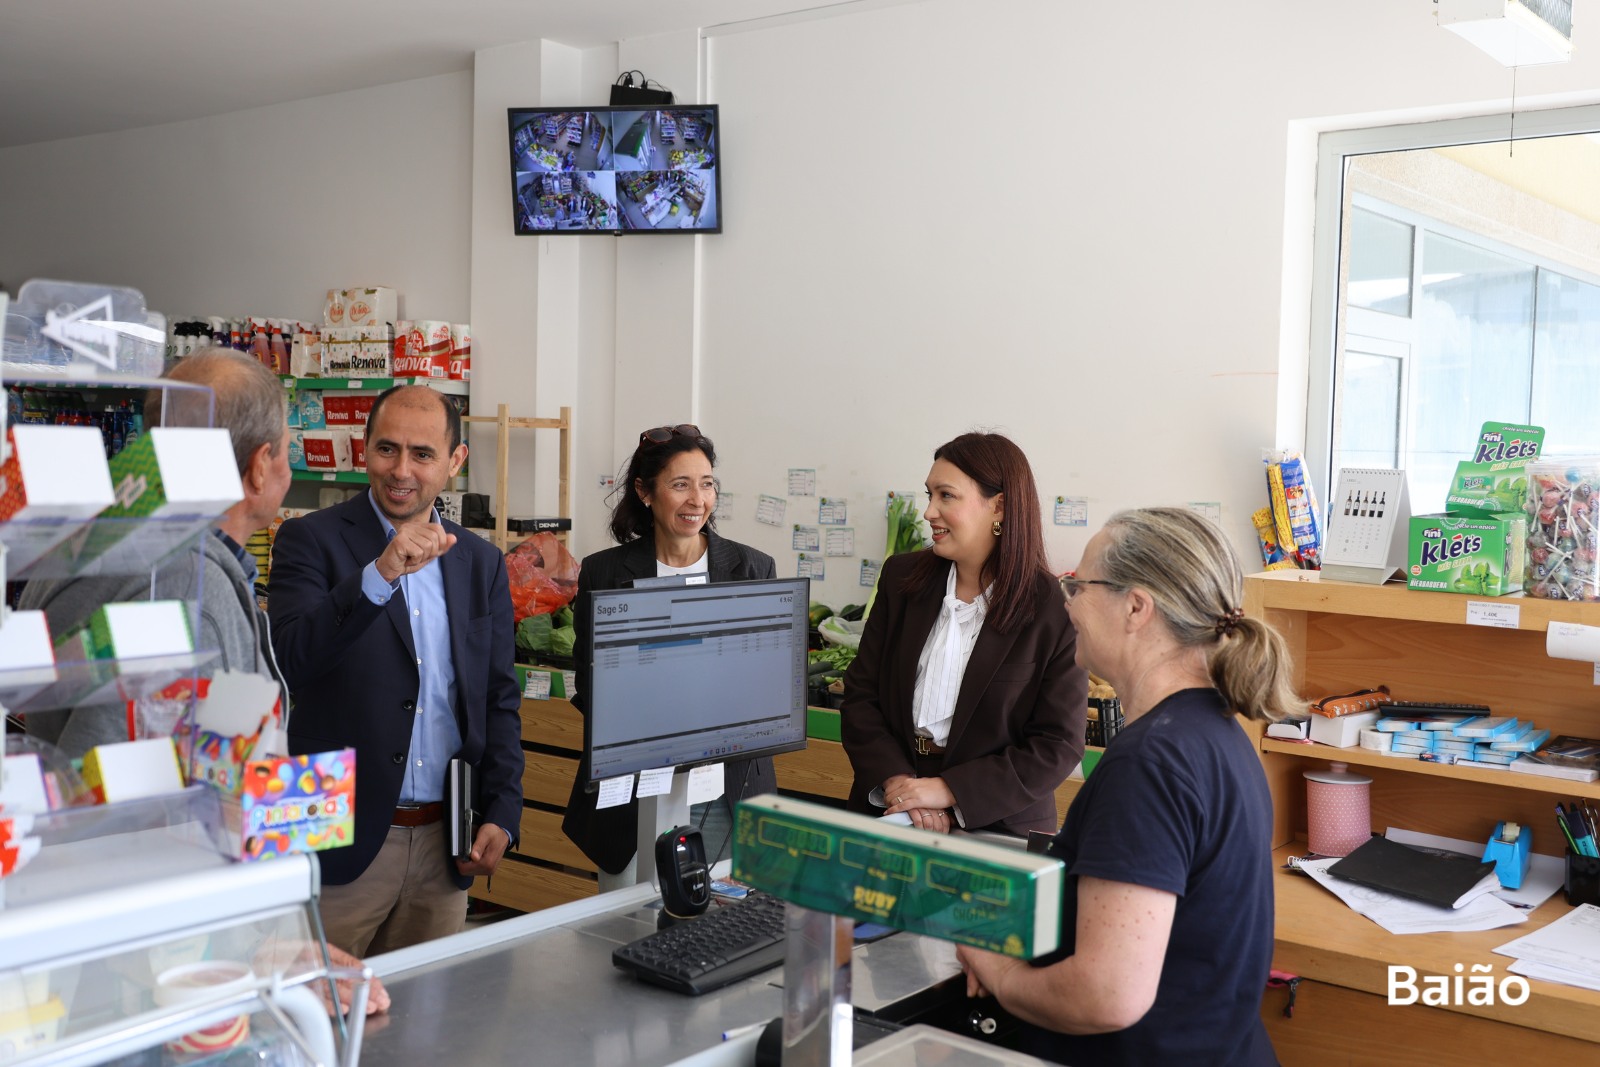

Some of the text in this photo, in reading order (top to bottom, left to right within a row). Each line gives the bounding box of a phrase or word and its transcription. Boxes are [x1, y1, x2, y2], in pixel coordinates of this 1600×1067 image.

[351, 355, 386, 369] Renova
[394, 357, 431, 372] enova
[327, 411, 349, 420] Renova
[307, 452, 330, 462] Renova
[597, 603, 628, 616] Sage 50
[853, 885, 897, 911] RUBY
